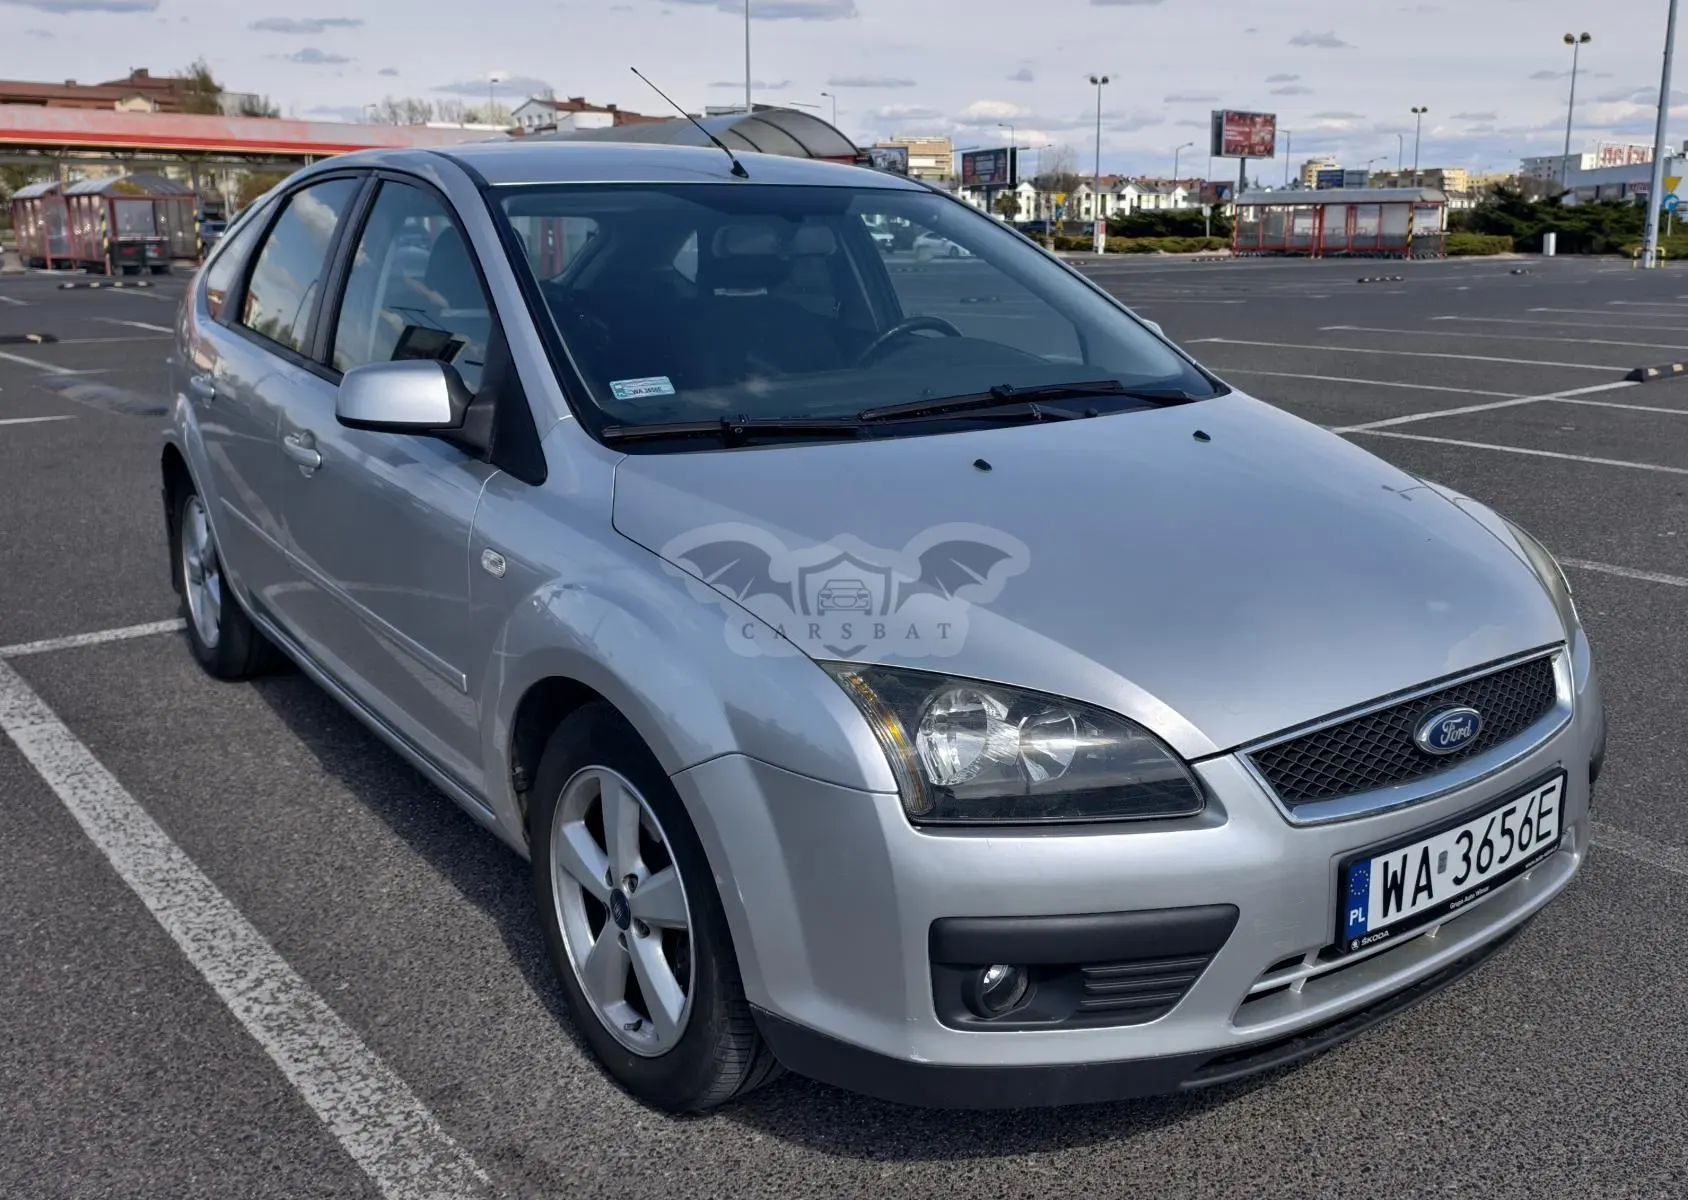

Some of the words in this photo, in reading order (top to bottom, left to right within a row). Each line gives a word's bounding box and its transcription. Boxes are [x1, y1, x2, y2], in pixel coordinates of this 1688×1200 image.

[1440, 717, 1472, 745] Ford
[1382, 845, 1434, 918] WA
[1452, 784, 1557, 887] 3656E
[1349, 907, 1366, 926] PL
